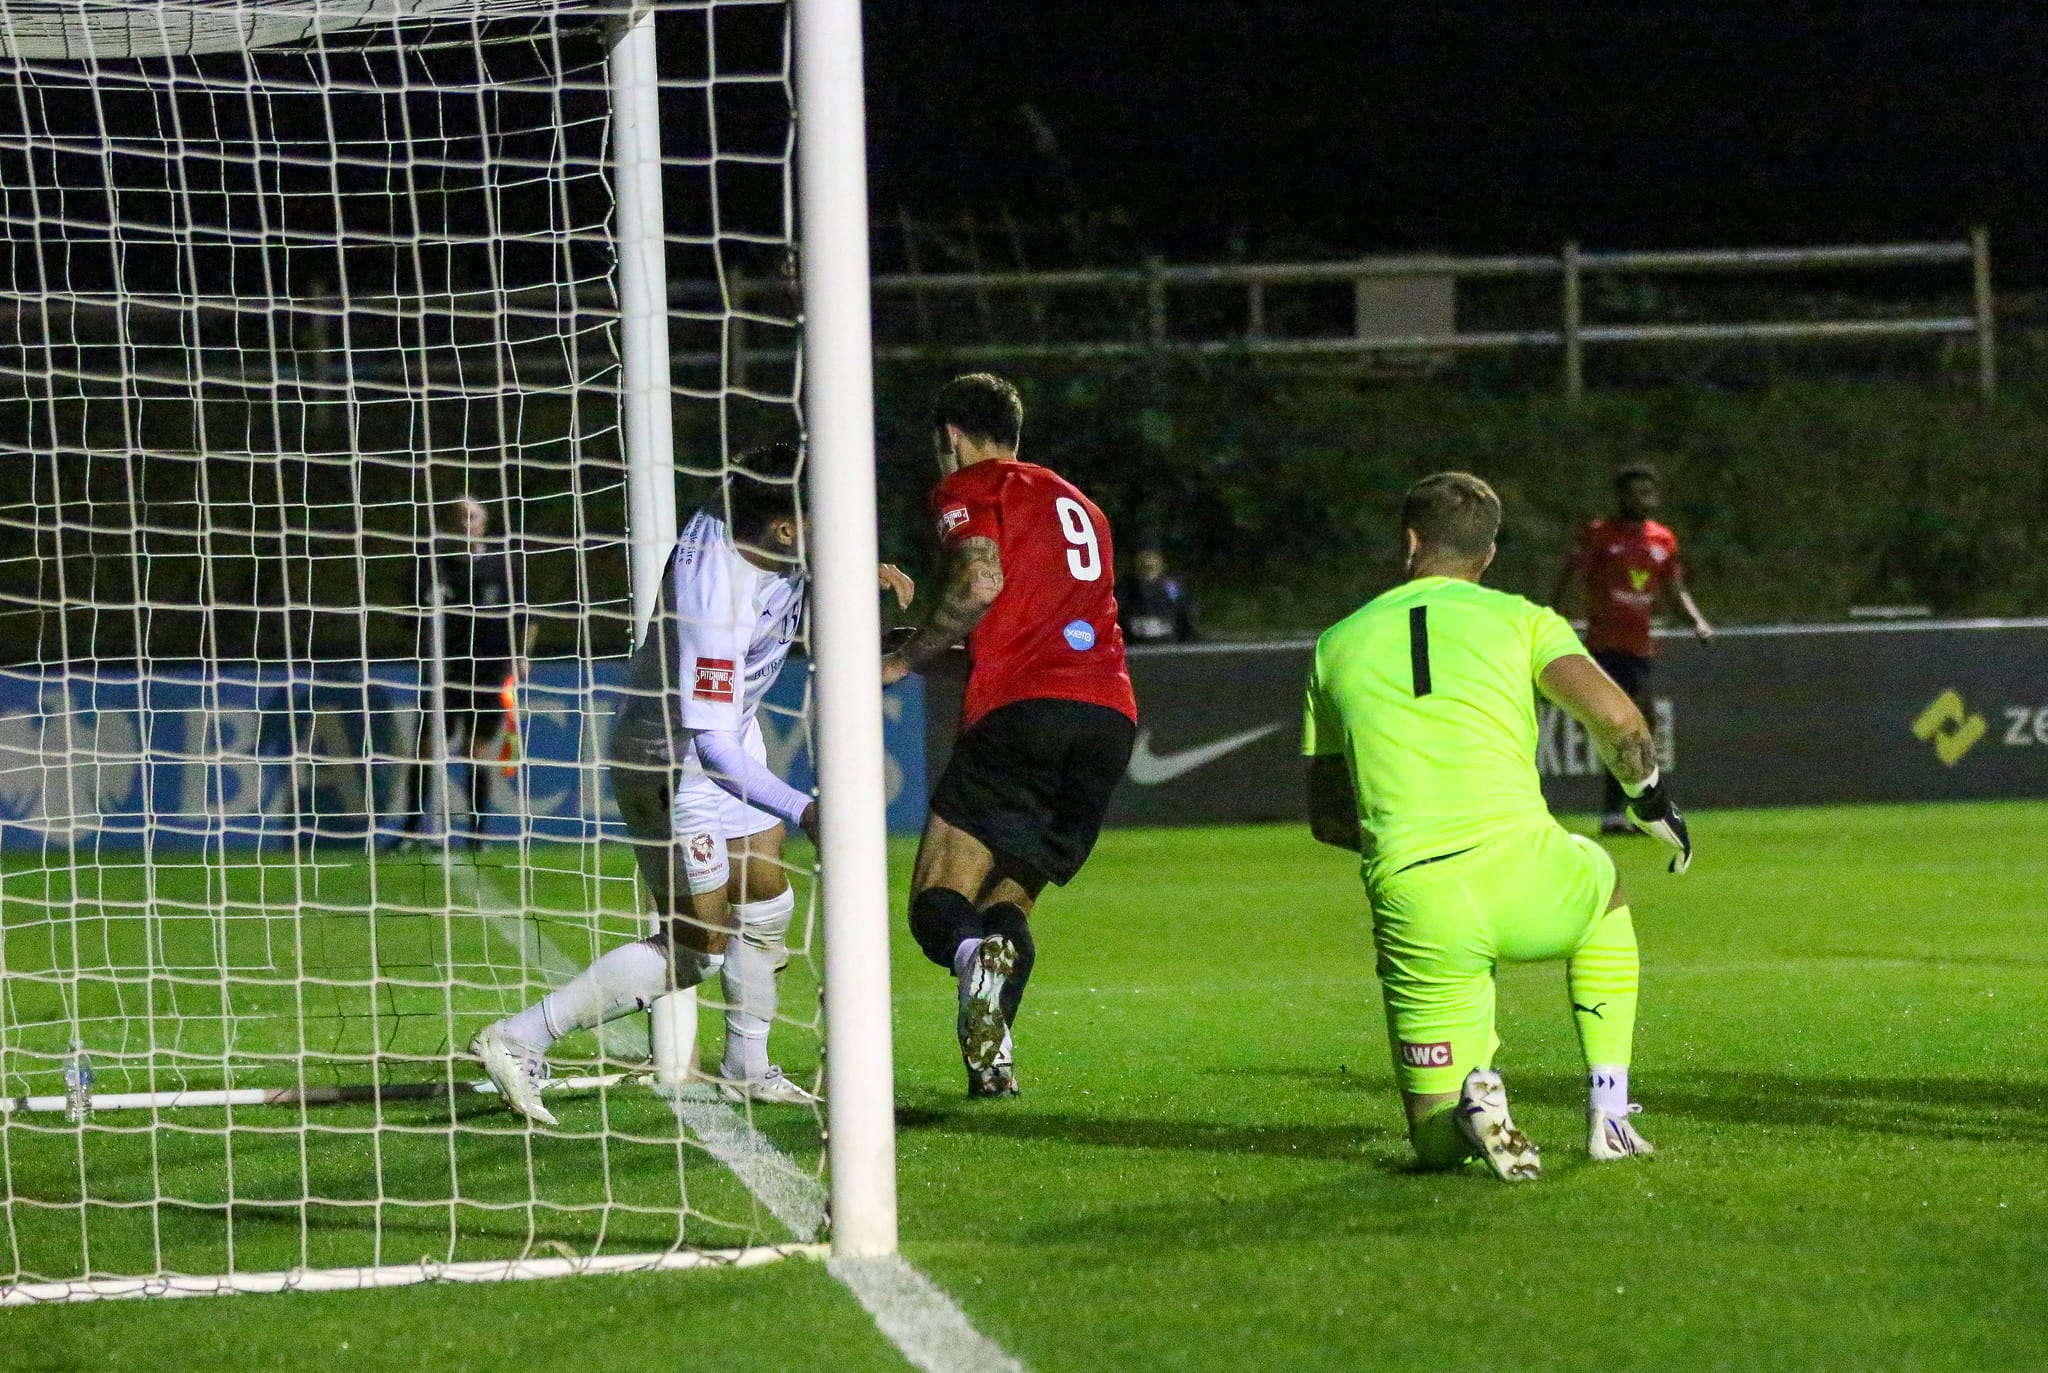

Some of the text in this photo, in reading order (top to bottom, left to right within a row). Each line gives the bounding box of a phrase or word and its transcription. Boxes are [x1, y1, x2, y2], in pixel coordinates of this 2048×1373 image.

[1056, 497, 1101, 581] 9
[1066, 628, 1092, 642] xero
[1409, 605, 1432, 698] 1
[700, 670, 729, 682] PITCHING
[712, 680, 719, 690] IN
[1403, 1045, 1450, 1066] LWC
